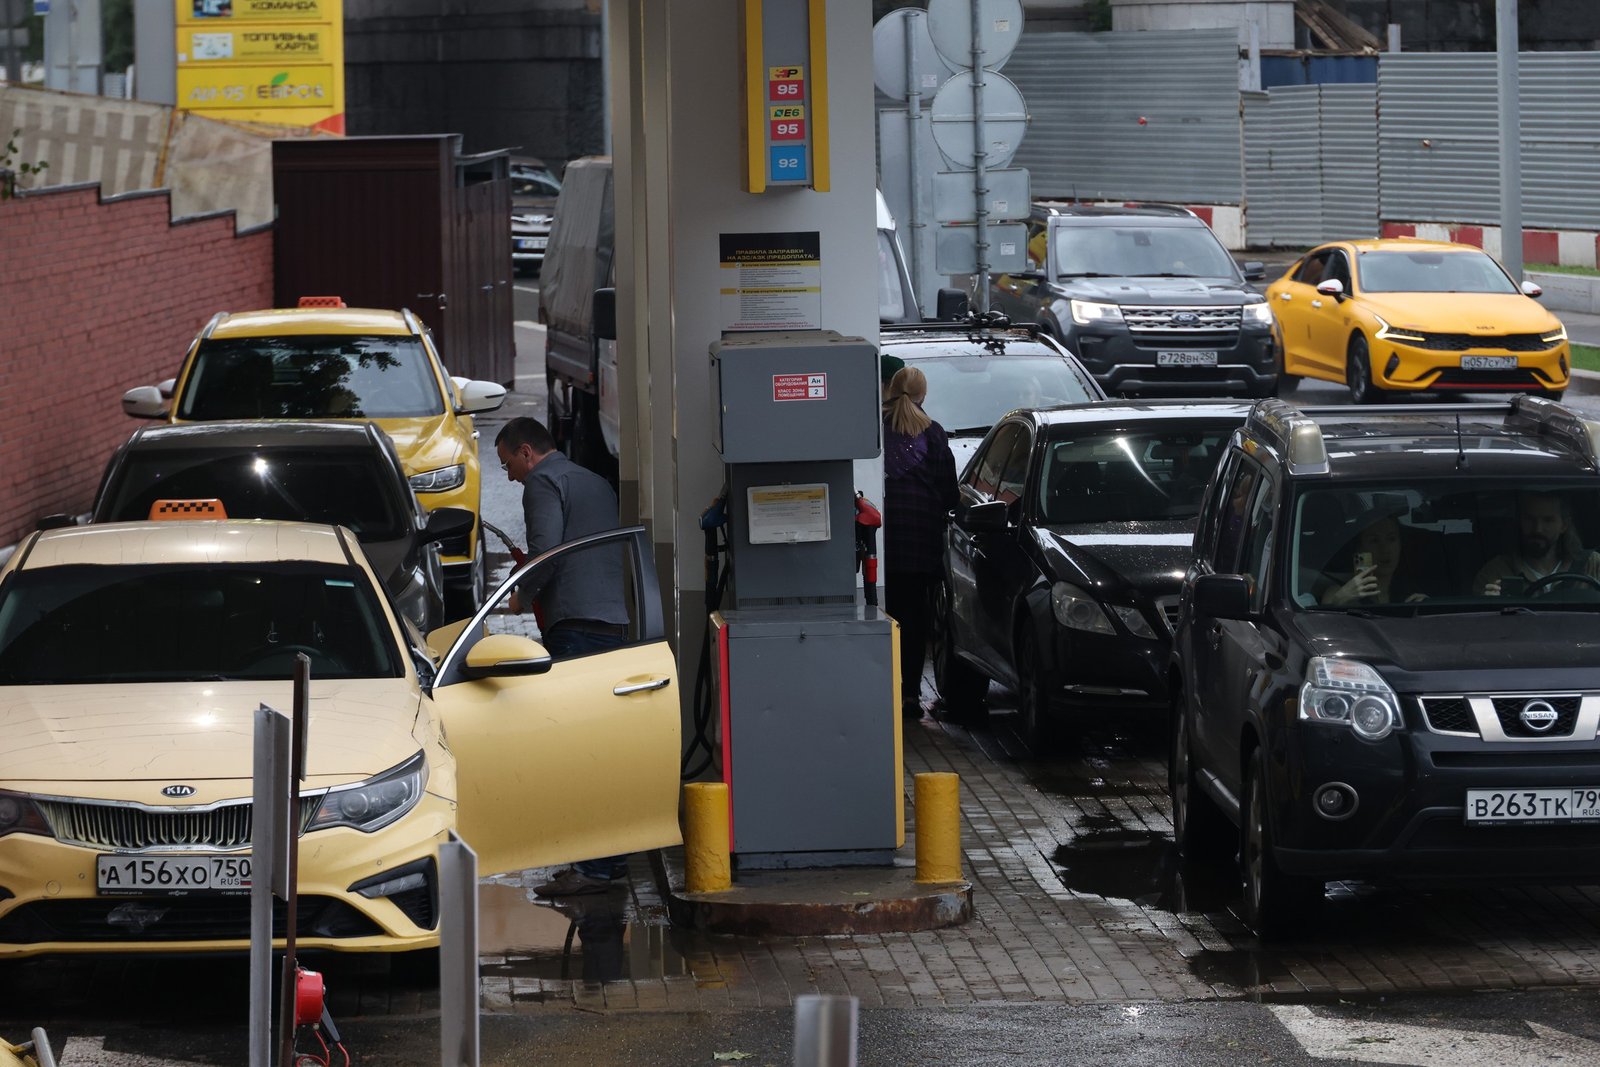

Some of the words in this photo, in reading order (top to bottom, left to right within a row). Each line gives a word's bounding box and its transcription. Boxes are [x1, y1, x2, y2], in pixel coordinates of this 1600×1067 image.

[251, 1, 317, 10] КОМАНДА
[242, 32, 318, 43] ТОПЛИВНЫЕ
[275, 42, 319, 51] КАРТЫ
[777, 84, 798, 95] 95
[777, 124, 798, 135] 95
[778, 158, 798, 168] 92
[166, 786, 191, 794] KIA
[1475, 792, 1568, 817] В263ТК
[1574, 790, 1600, 809] 79
[1582, 808, 1600, 816] RUS
[106, 860, 207, 885] А156ХО
[212, 859, 251, 878] 750
